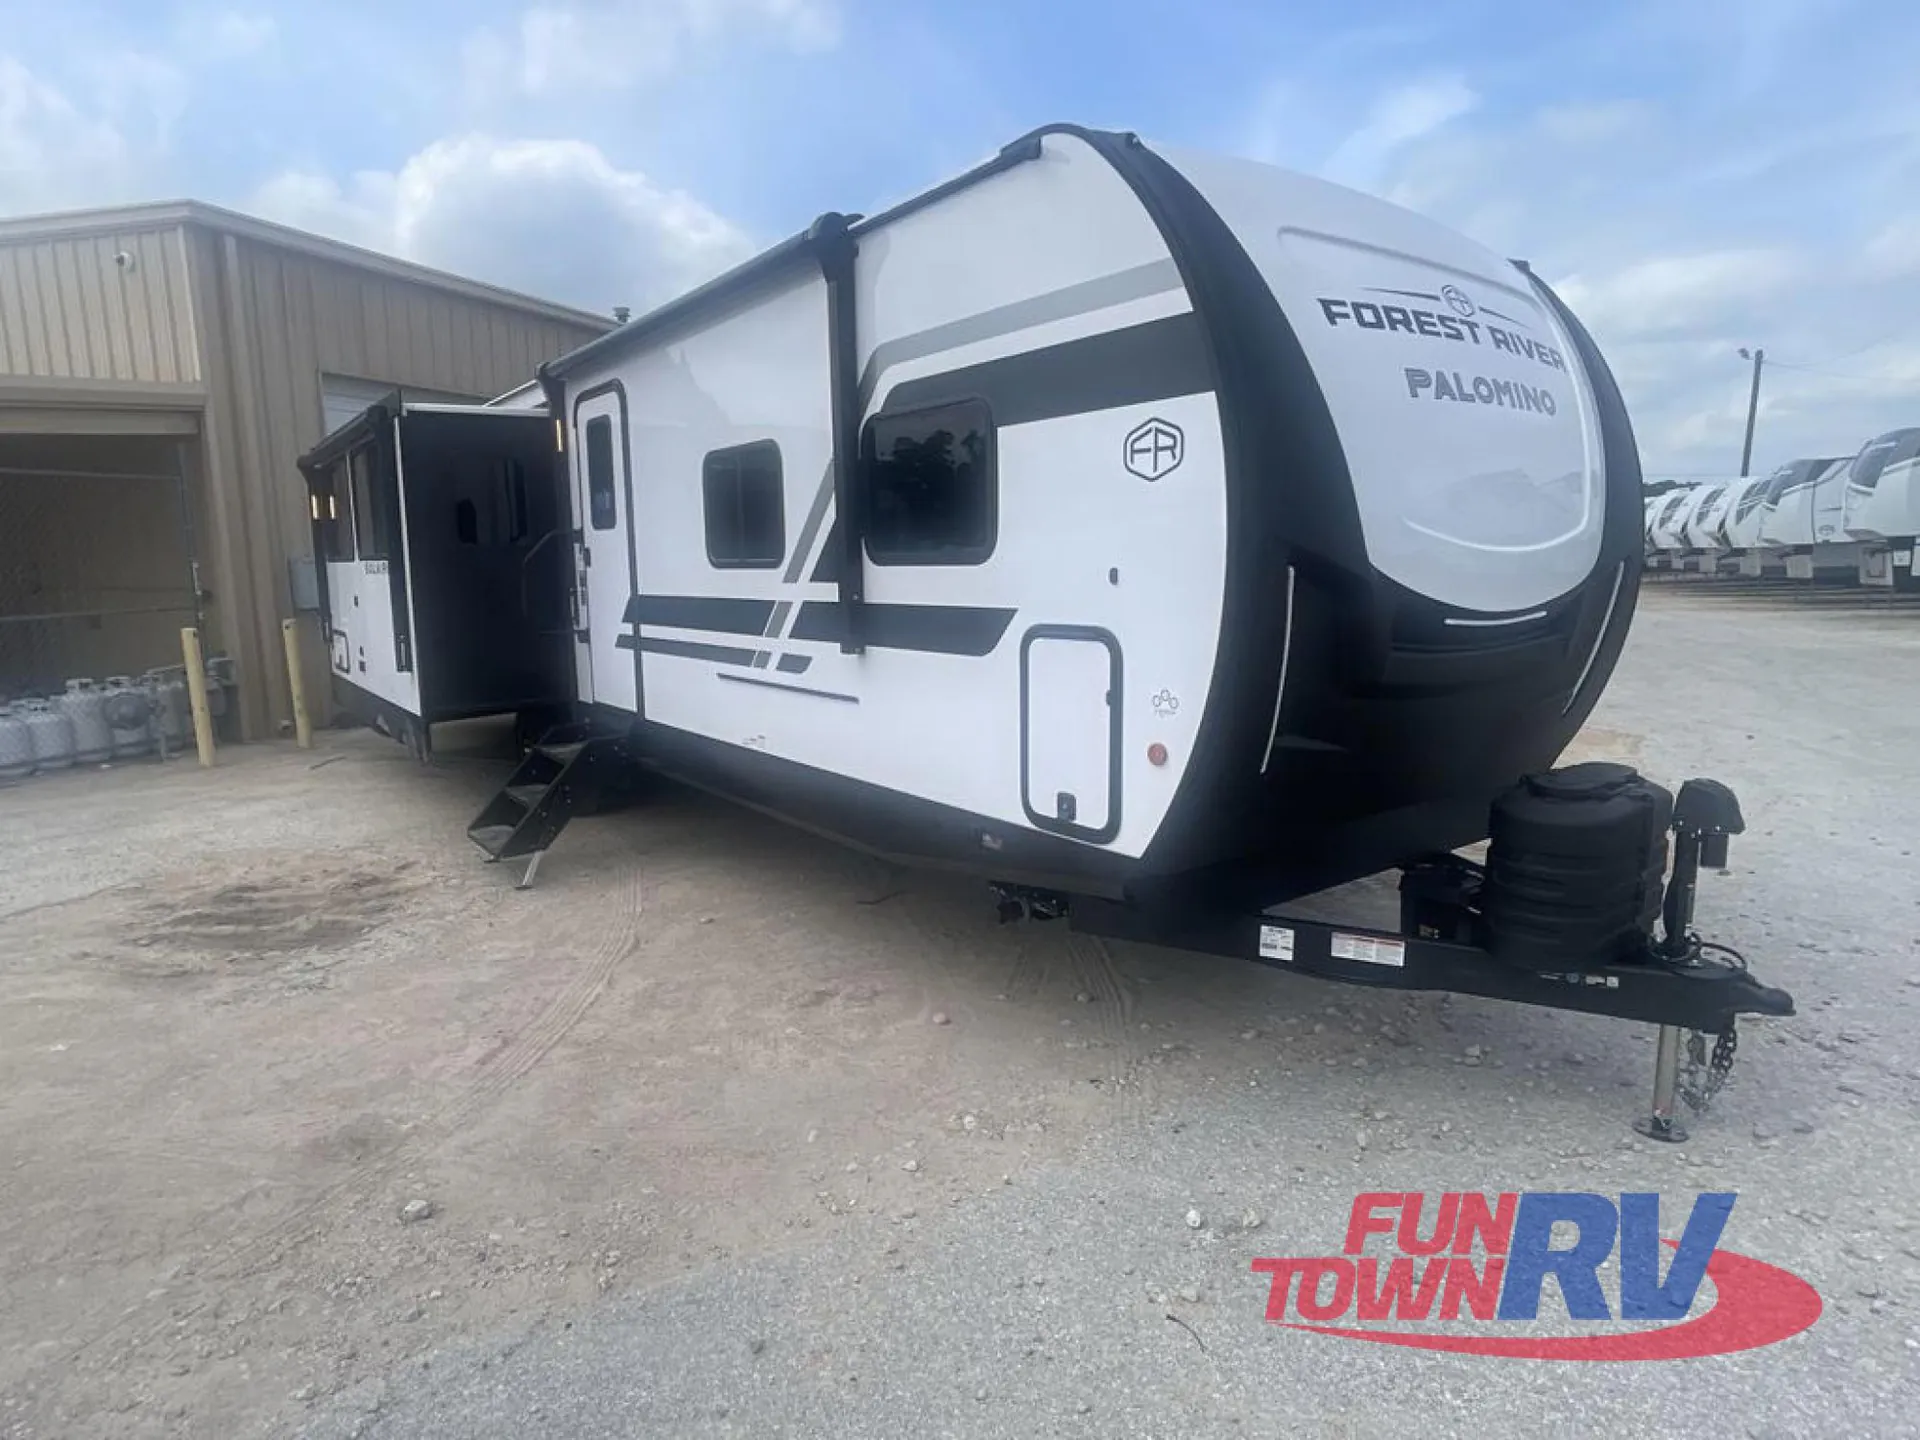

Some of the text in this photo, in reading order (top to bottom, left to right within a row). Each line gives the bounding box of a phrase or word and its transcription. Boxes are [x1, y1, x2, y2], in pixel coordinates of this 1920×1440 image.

[1316, 297, 1480, 345] FOREST
[1486, 324, 1567, 373] RIVER
[1404, 367, 1556, 416] PALOMINO
